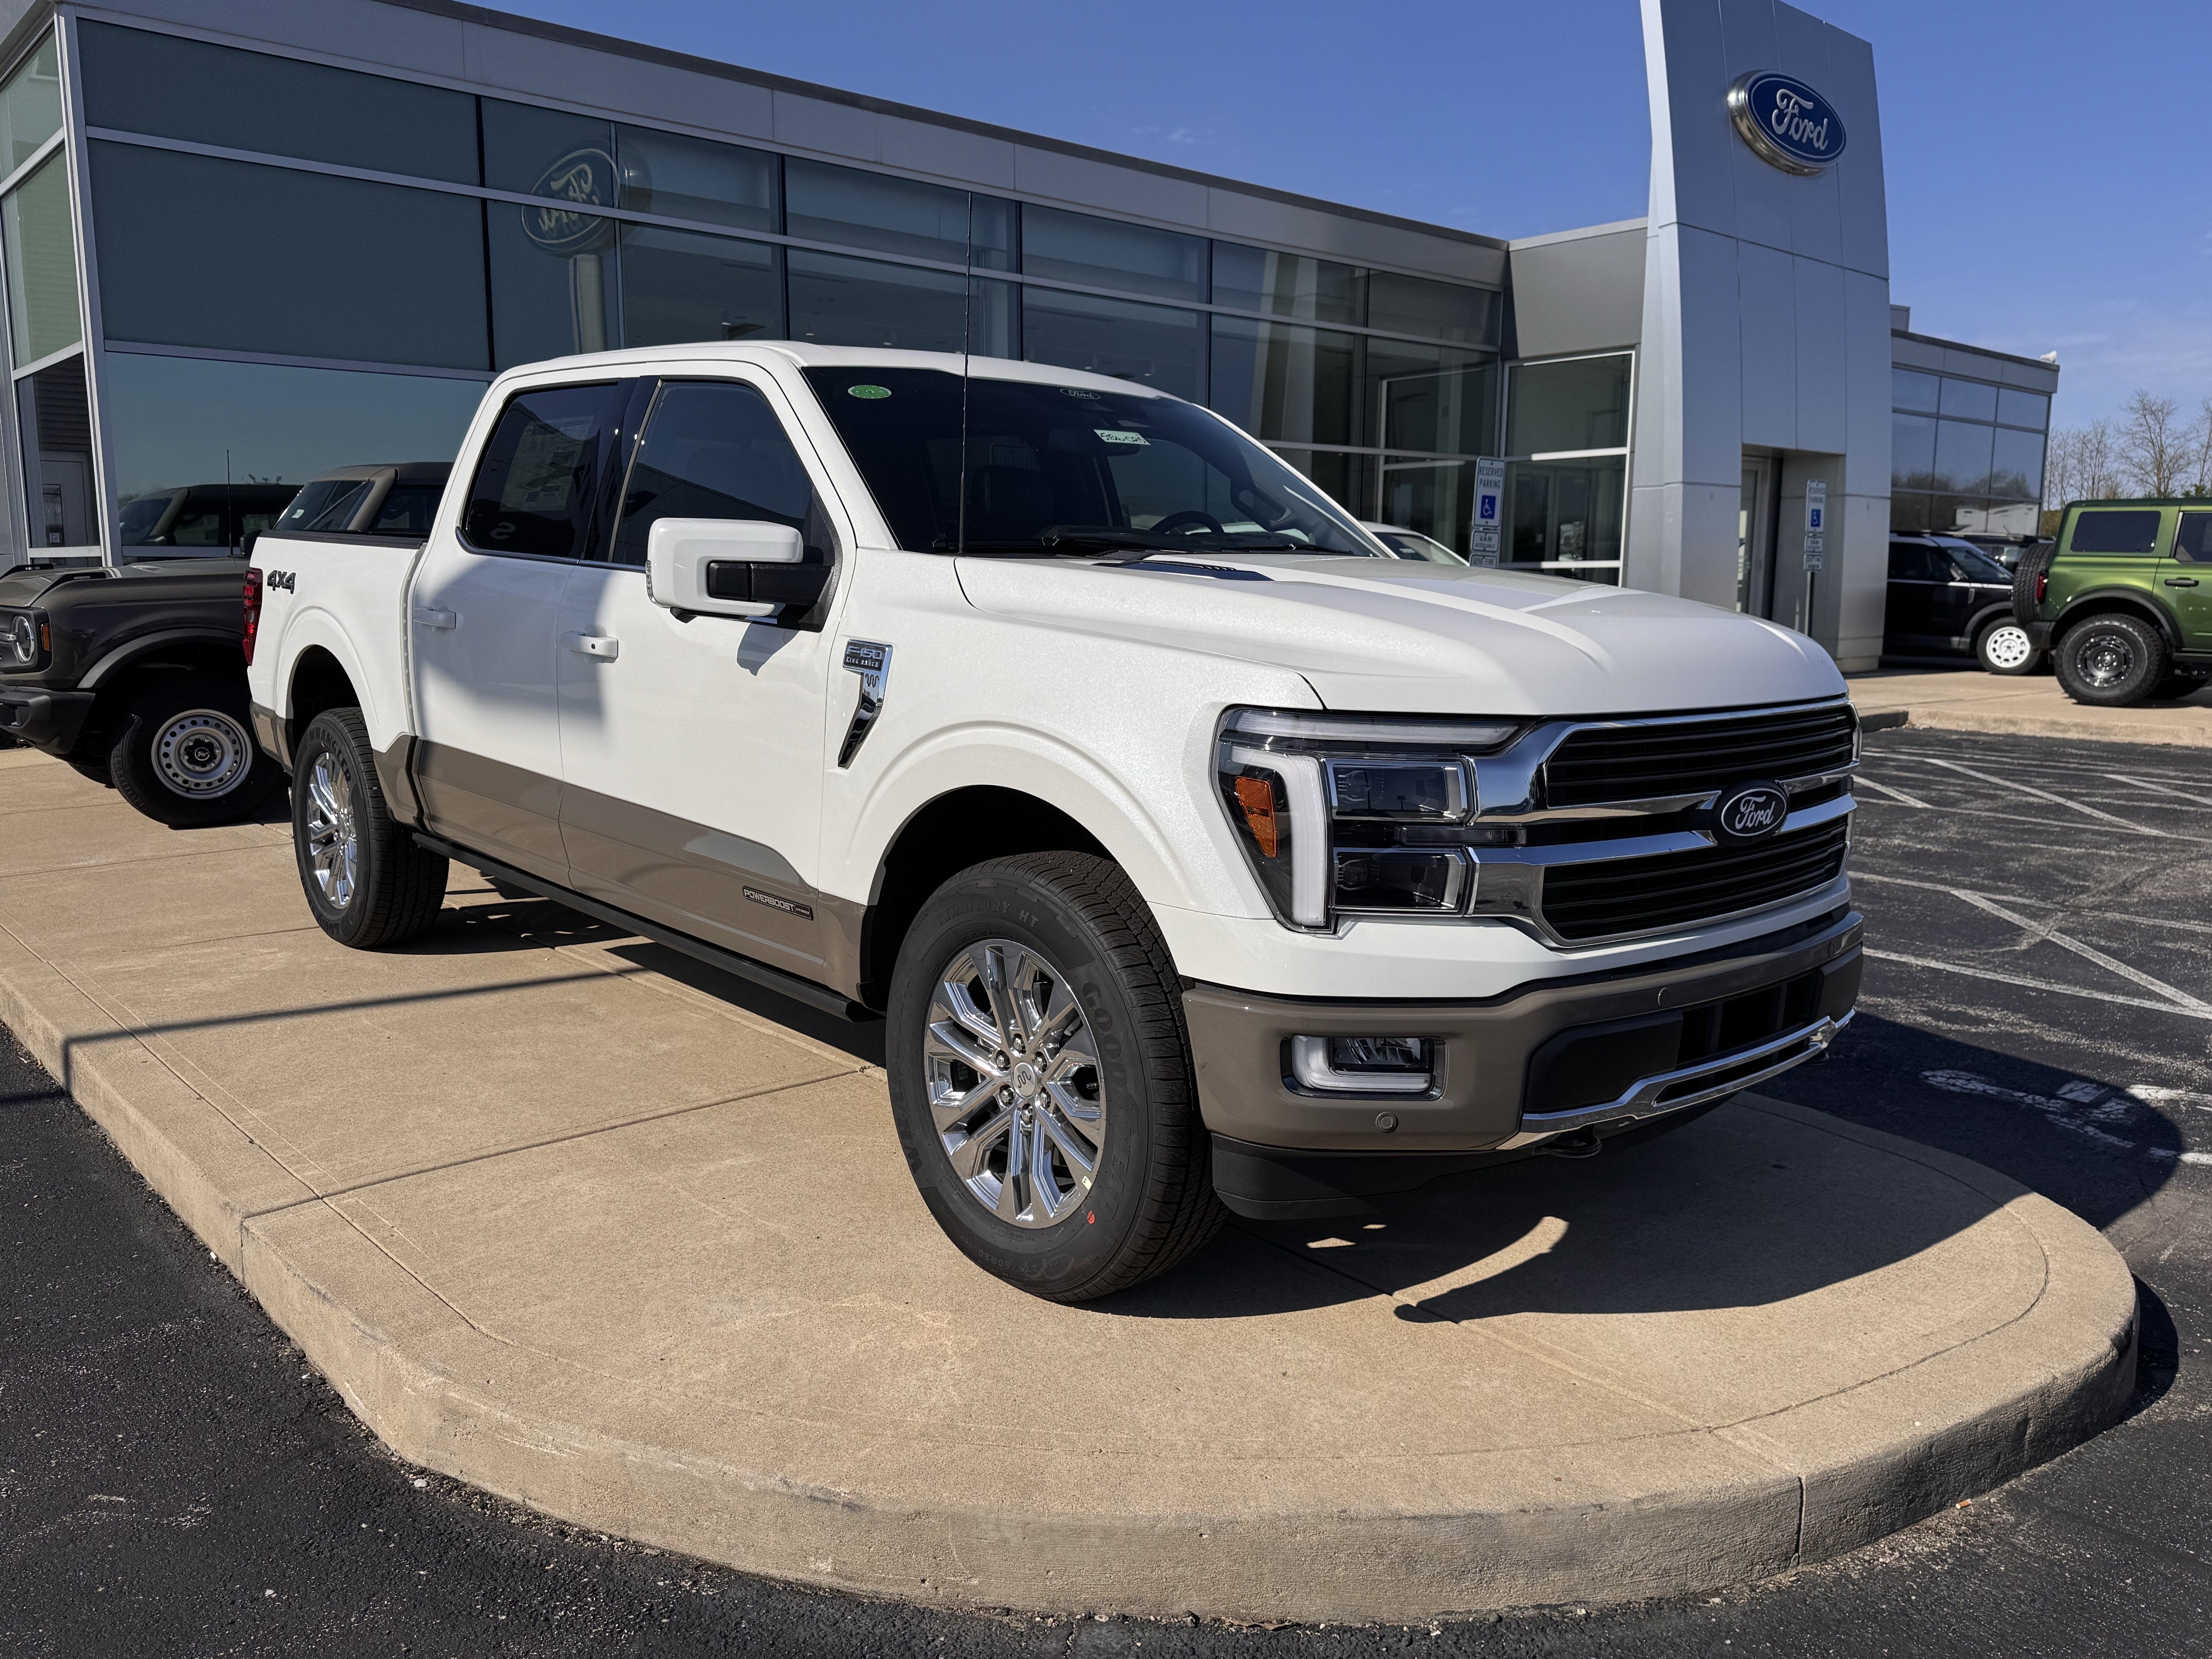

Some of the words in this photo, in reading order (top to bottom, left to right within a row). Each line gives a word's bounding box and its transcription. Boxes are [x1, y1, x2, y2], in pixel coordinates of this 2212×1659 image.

[1772, 88, 1829, 151] Ford
[1068, 389, 1094, 398] Ford
[1479, 466, 1503, 477] RESERVED
[1479, 479, 1501, 489] PARKING
[1480, 534, 1492, 543] VAN
[860, 659, 879, 668] RANCH
[309, 726, 351, 782] WRANGLER
[1735, 795, 1776, 830] Ford
[743, 888, 795, 912] POWERBOOST
[936, 898, 1012, 926] TERRITORY
[1018, 908, 1040, 928] HT
[1083, 981, 1132, 1222] GOODYEAR
